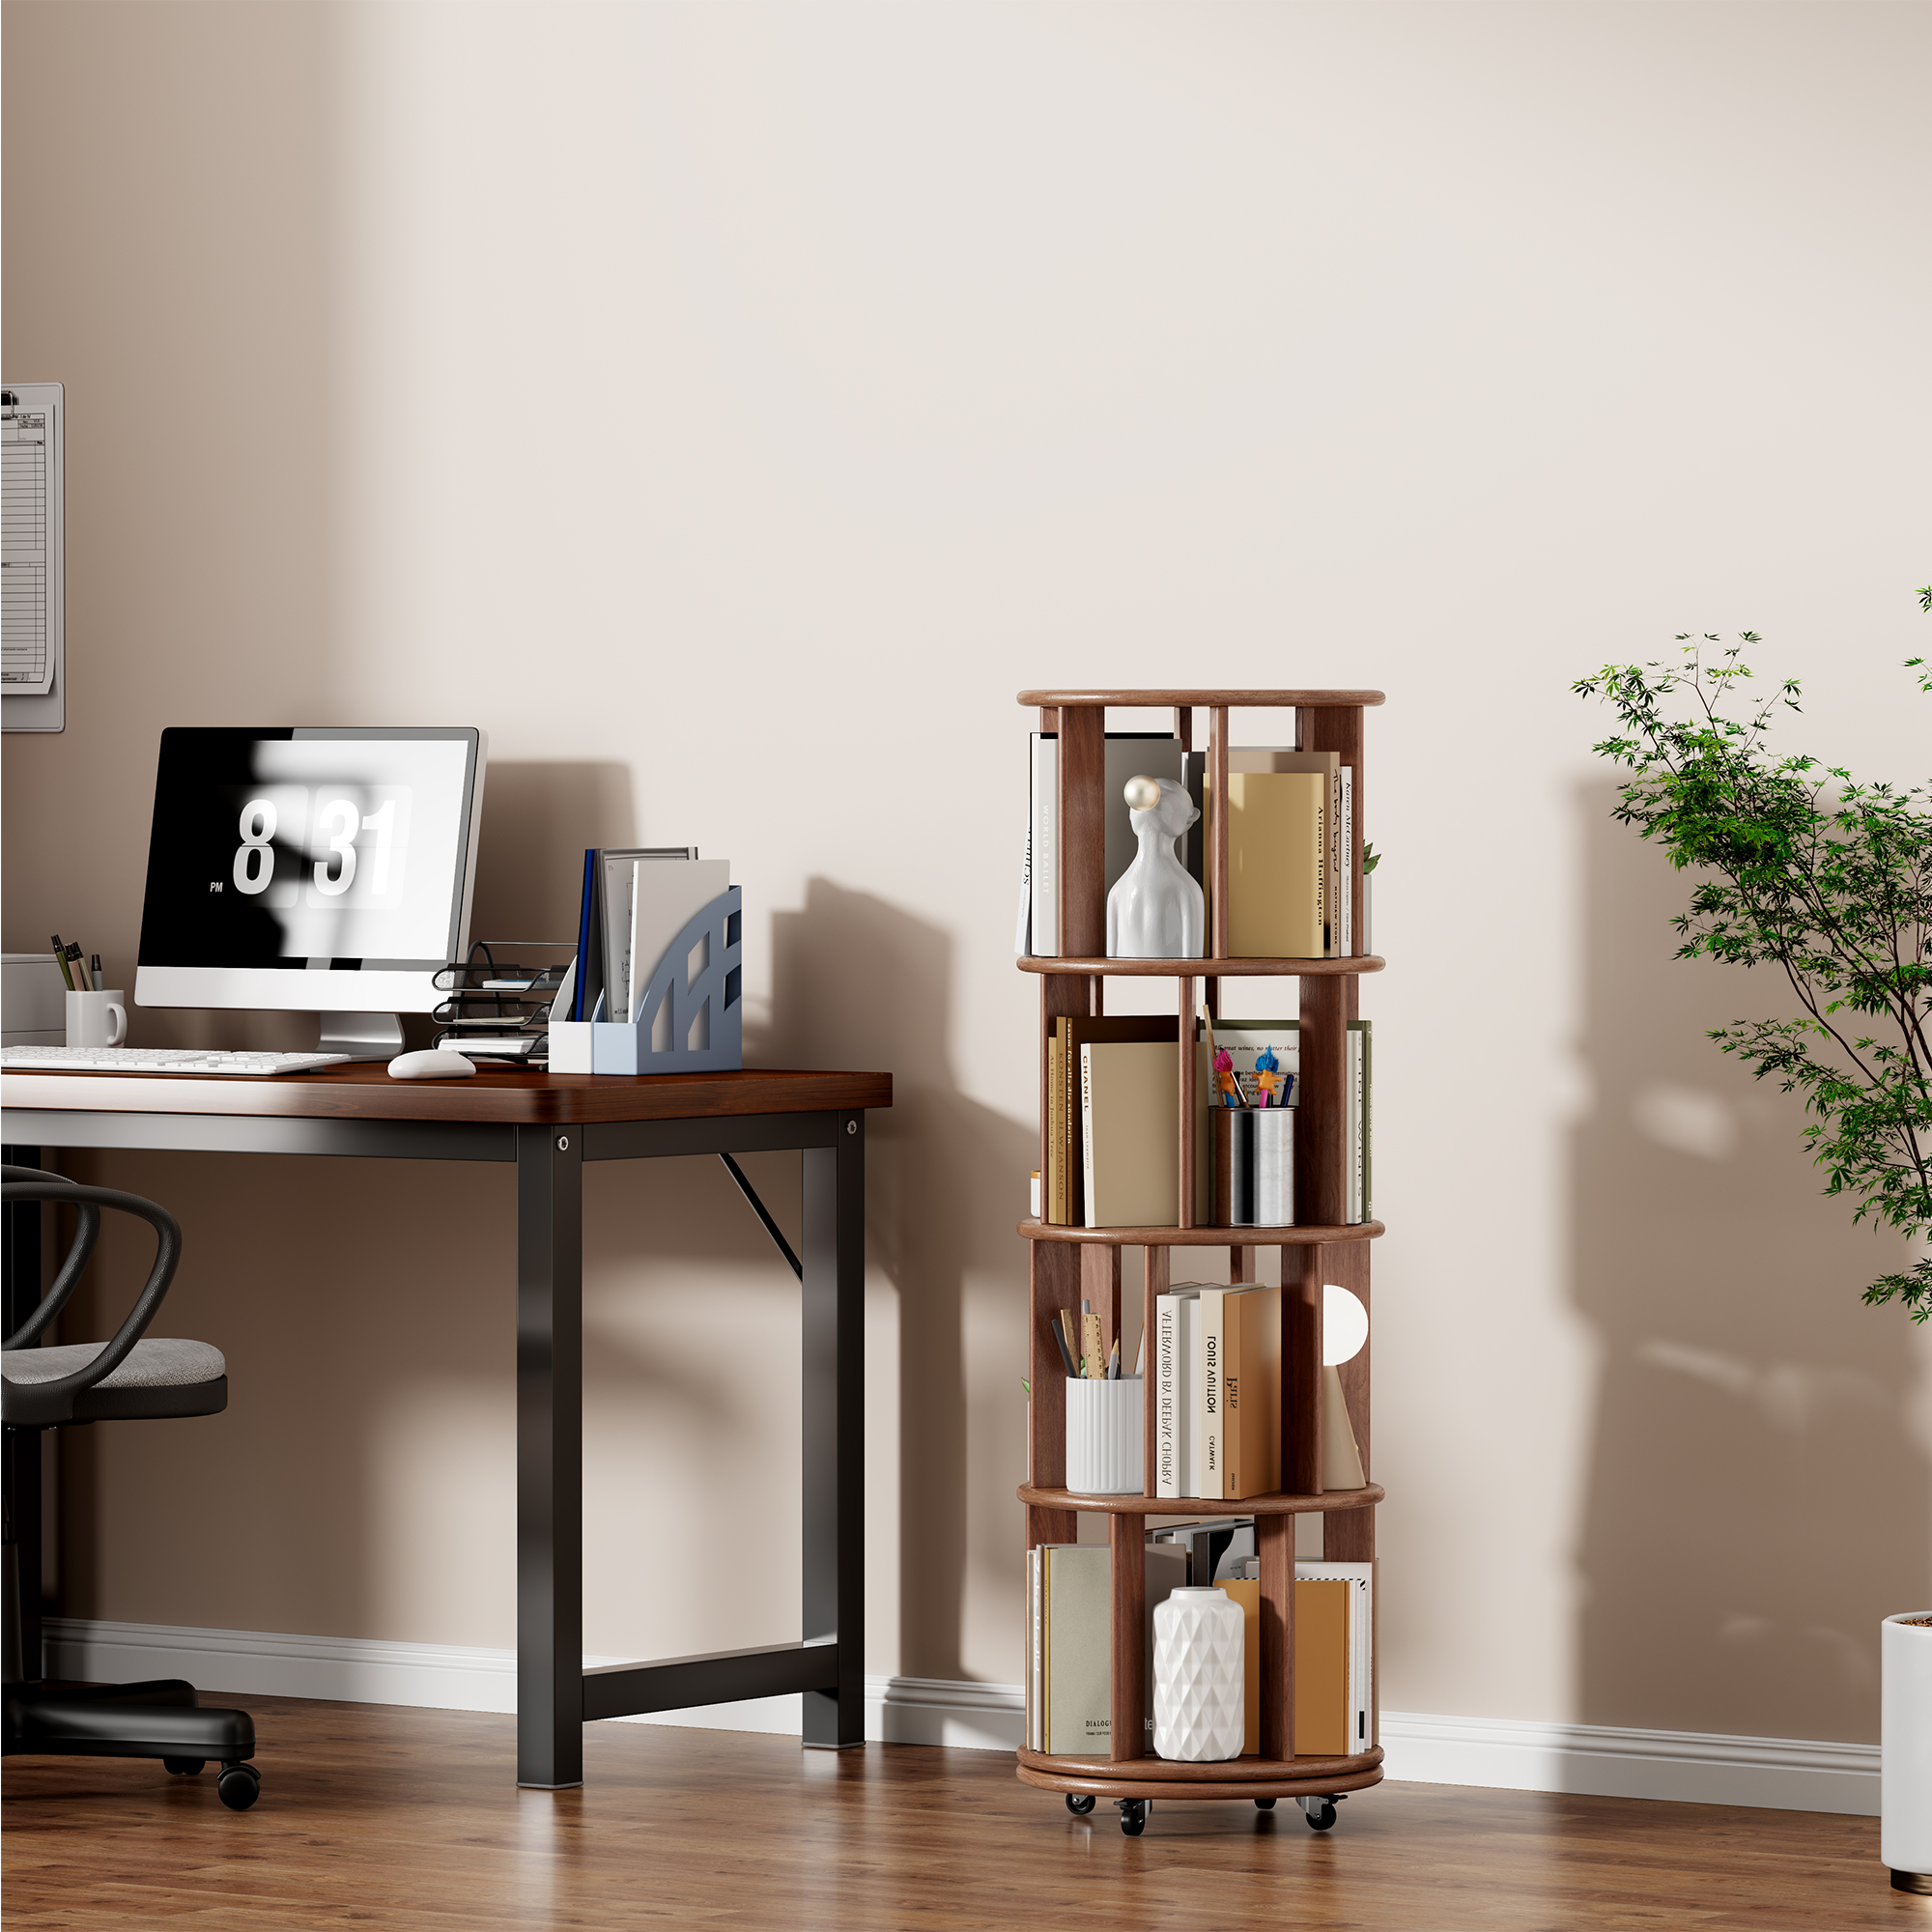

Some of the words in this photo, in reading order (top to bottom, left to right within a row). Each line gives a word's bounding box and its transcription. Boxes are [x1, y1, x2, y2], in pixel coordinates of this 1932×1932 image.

[210, 882, 223, 893] PM
[233, 799, 277, 895] 8
[313, 799, 396, 895] 31
